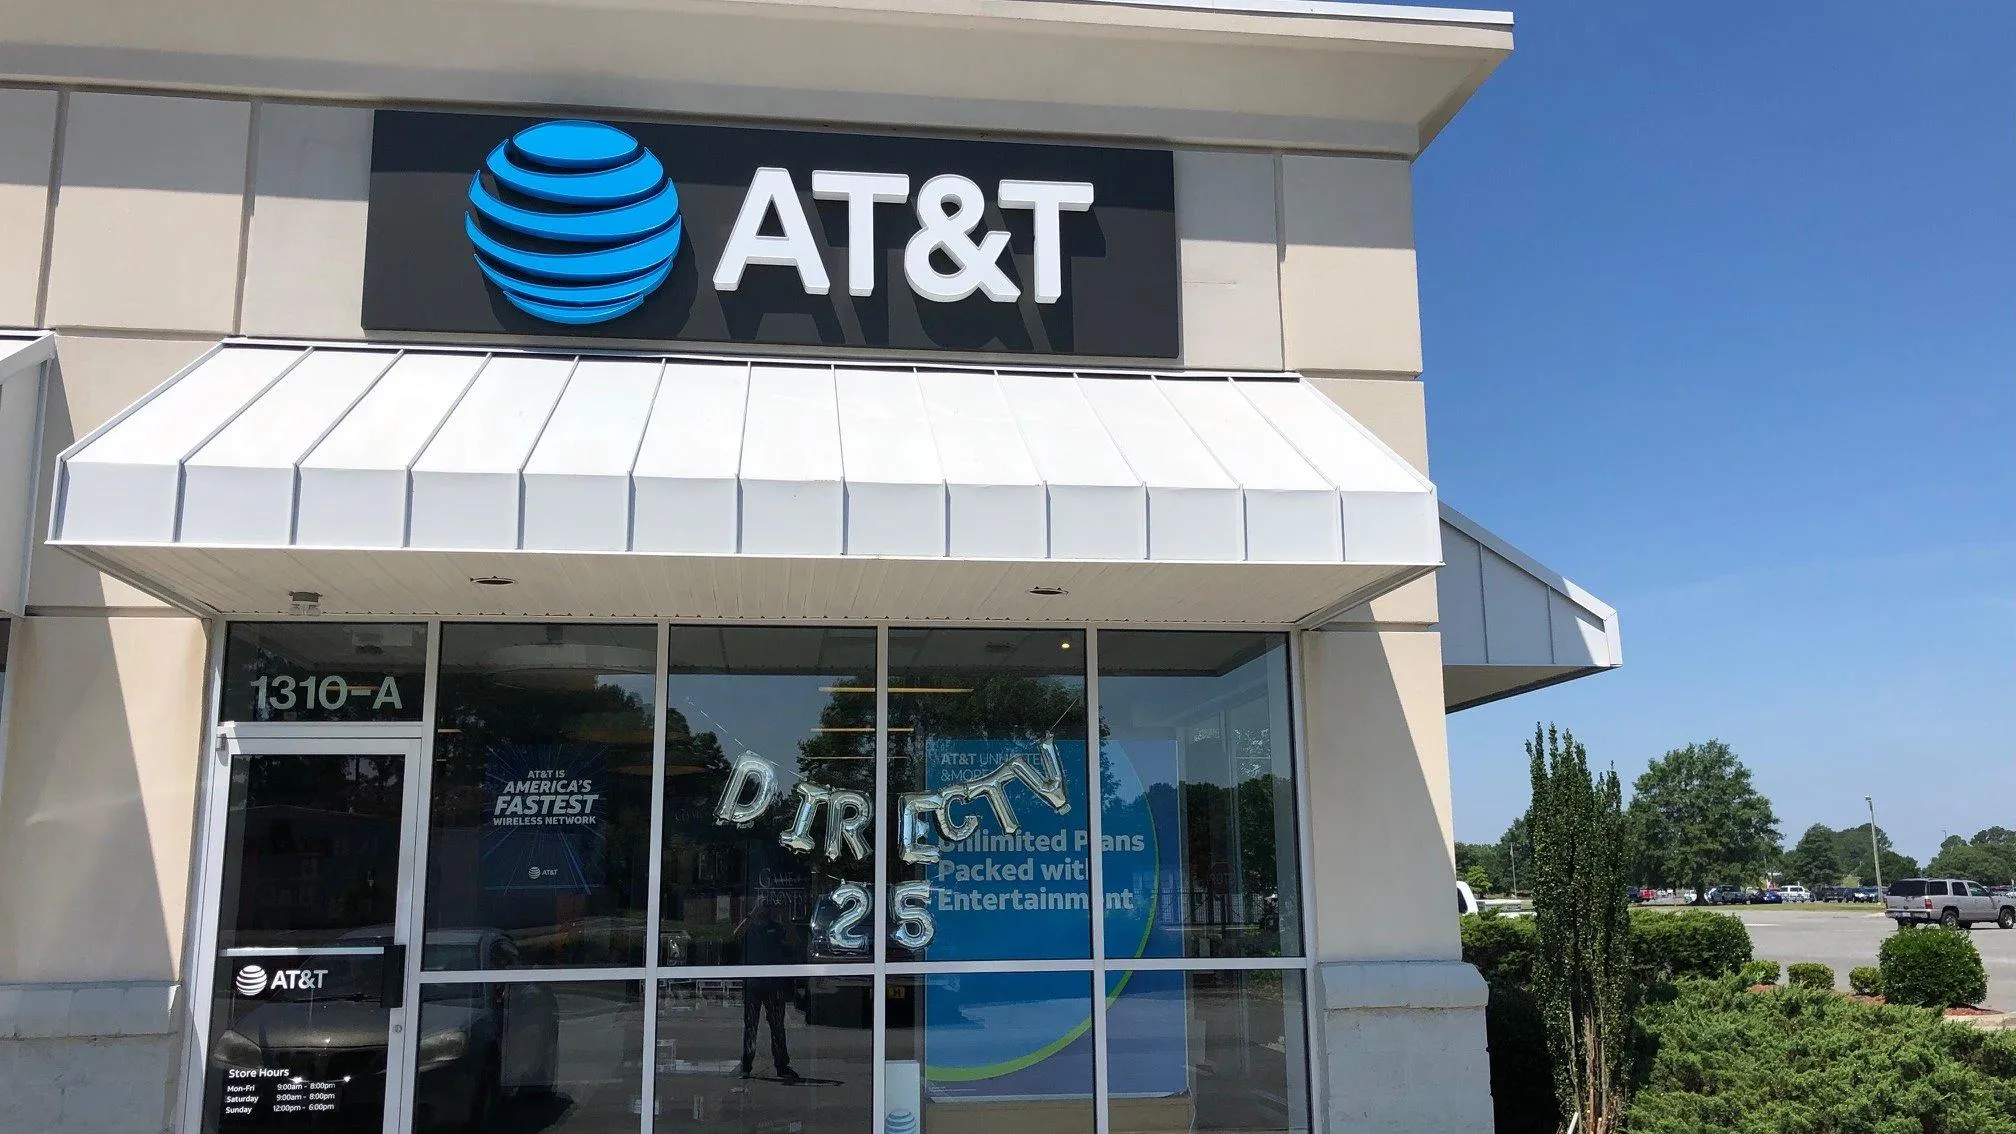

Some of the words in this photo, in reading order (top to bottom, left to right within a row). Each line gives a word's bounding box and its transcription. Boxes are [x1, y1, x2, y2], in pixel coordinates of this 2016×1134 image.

[713, 167, 1094, 303] AT&T
[250, 675, 403, 710] 1310-A
[941, 753, 975, 765] AT&T
[527, 770, 552, 779] AT&T
[555, 770, 566, 778] IS
[502, 779, 592, 794] AMERICA'S
[494, 794, 600, 816] FASTEST
[493, 817, 543, 826] WIRELESS
[545, 816, 597, 825] NETWORK
[1074, 829, 1145, 851] Pans
[541, 868, 558, 876] AT&T
[938, 858, 1034, 881] Packed
[938, 886, 1134, 911] Entertainmnt
[828, 879, 938, 950] 25
[270, 969, 328, 990] AT&T
[228, 1069, 257, 1078] Store
[259, 1068, 290, 1077] Hours
[226, 1095, 259, 1103] Saturday
[225, 1106, 252, 1115] Sunday
[273, 1104, 301, 1112] 12:00pm
[308, 1103, 335, 1111] 6:00pm
